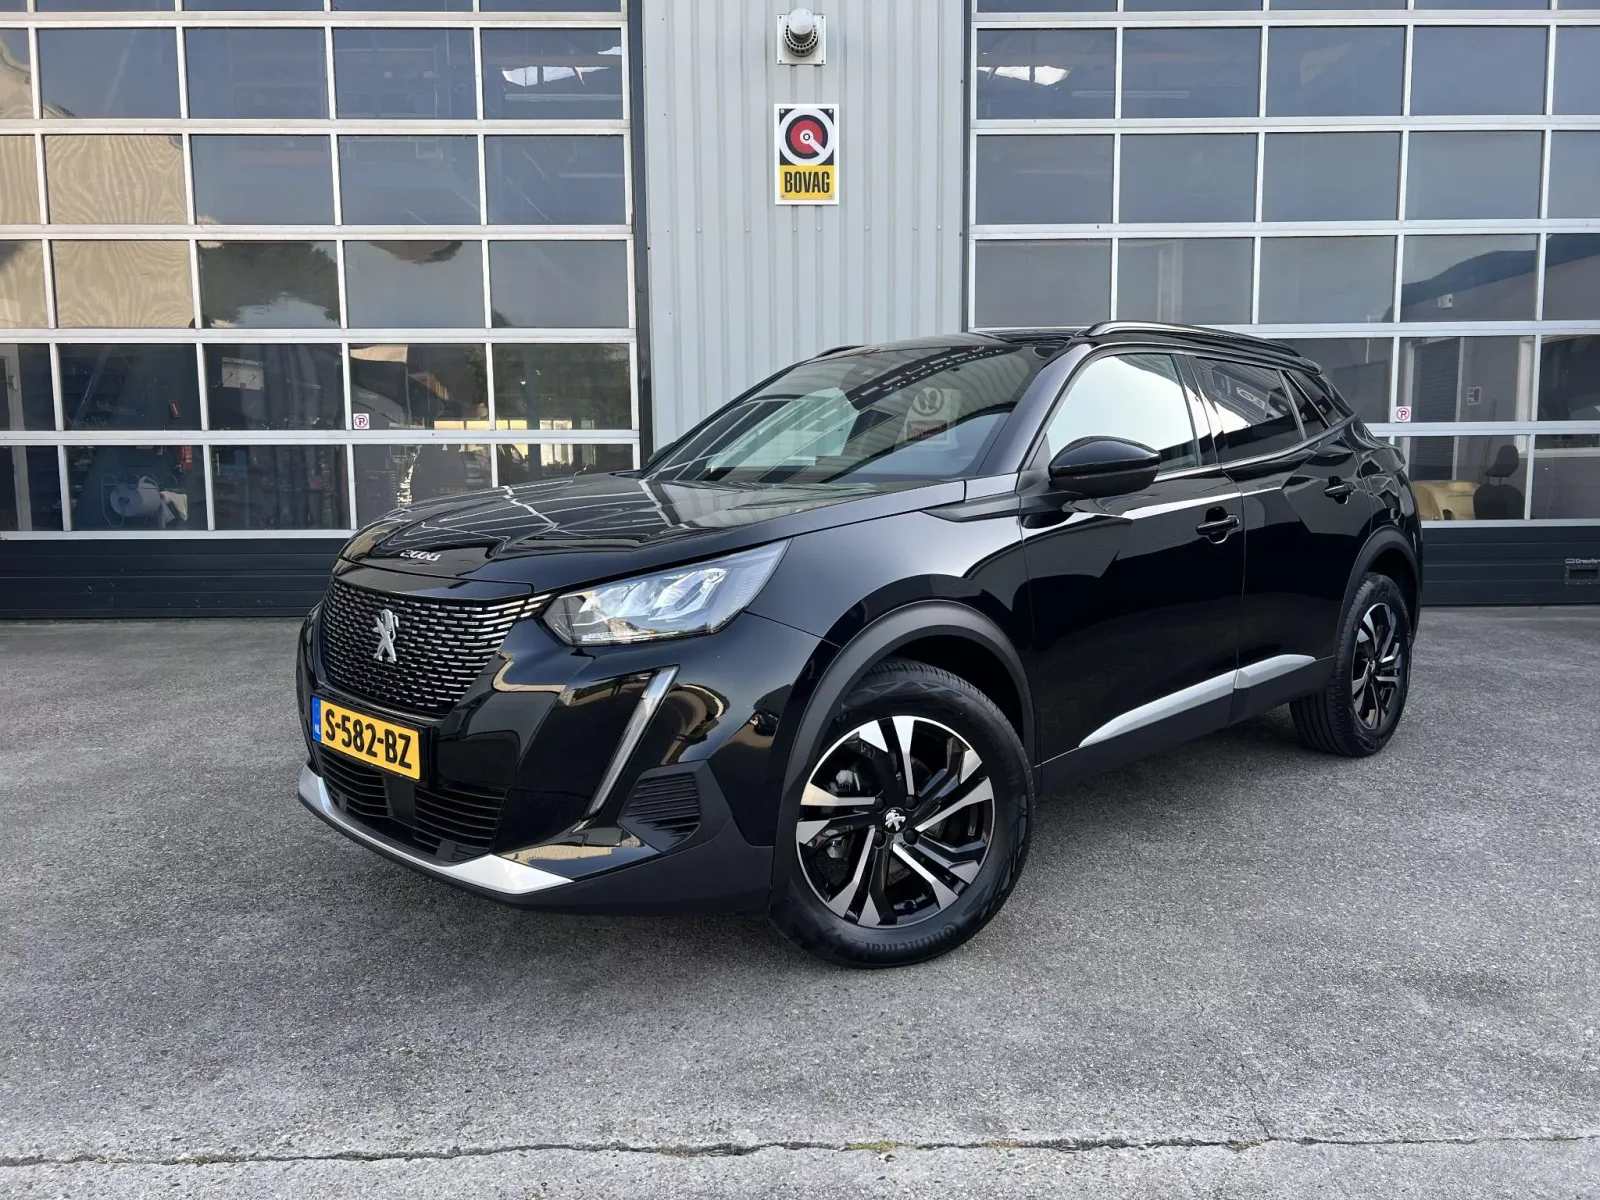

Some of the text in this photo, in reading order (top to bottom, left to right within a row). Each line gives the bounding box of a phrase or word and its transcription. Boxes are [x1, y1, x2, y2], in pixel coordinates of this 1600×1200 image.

[784, 171, 830, 193] BOVAG
[399, 549, 442, 562] 2008
[314, 723, 321, 735] NL
[325, 708, 412, 770] S-582-BZ
